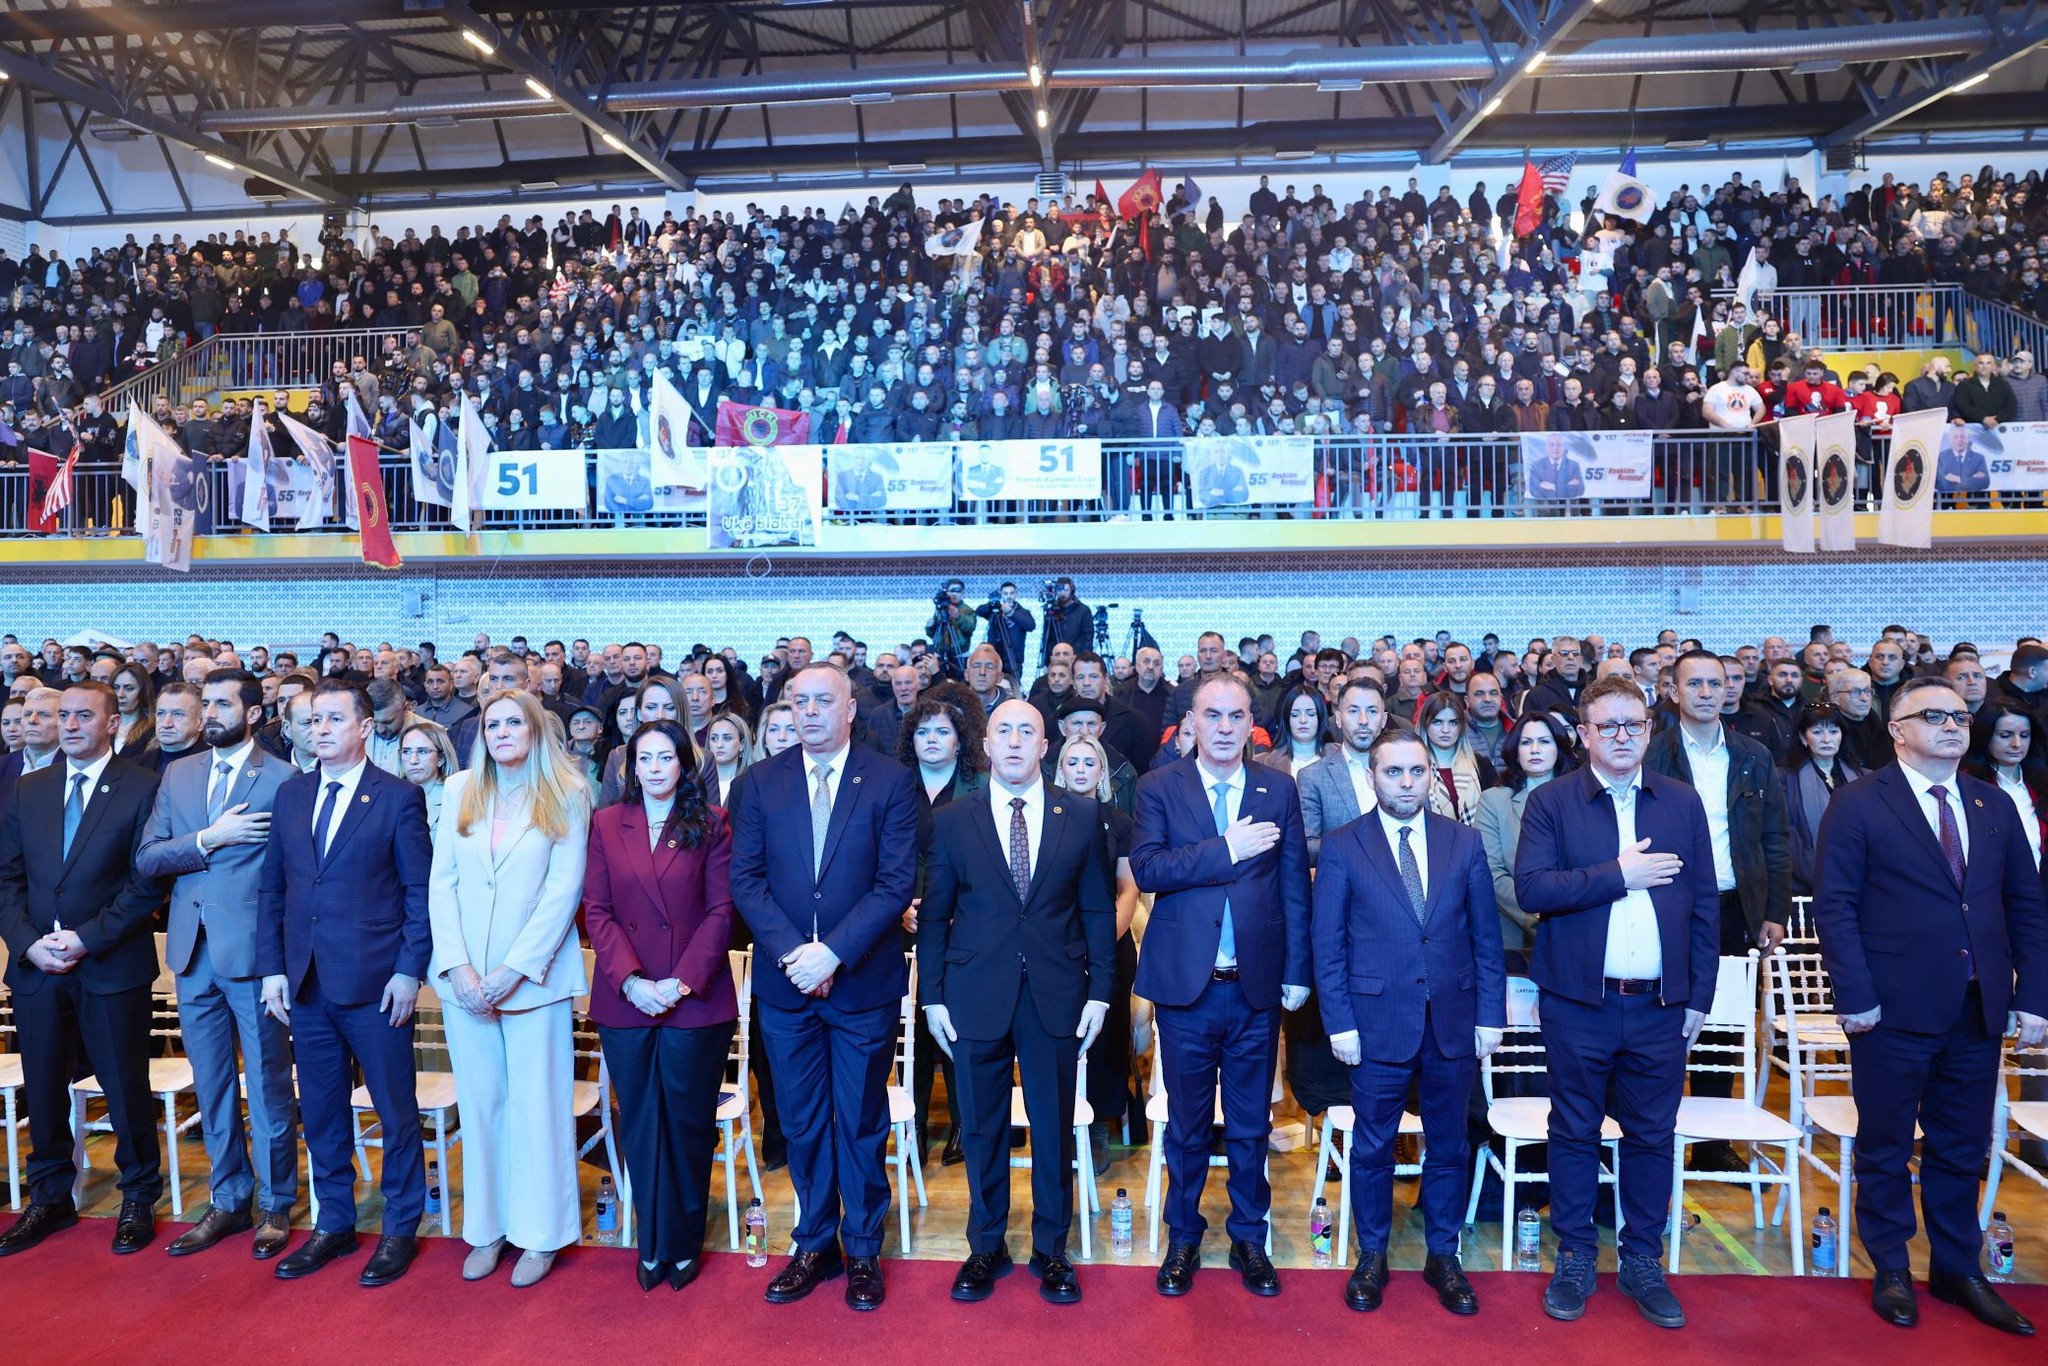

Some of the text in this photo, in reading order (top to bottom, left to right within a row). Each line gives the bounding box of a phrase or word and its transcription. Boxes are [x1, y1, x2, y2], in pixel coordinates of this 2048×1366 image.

[1038, 444, 1074, 473] 51
[1990, 459, 2013, 473] 55
[497, 462, 538, 496] 51
[1248, 473, 1269, 486] 55
[1585, 467, 1605, 480] 55
[887, 480, 907, 492] 55
[277, 490, 296, 502] 55
[723, 517, 752, 530] Ukë
